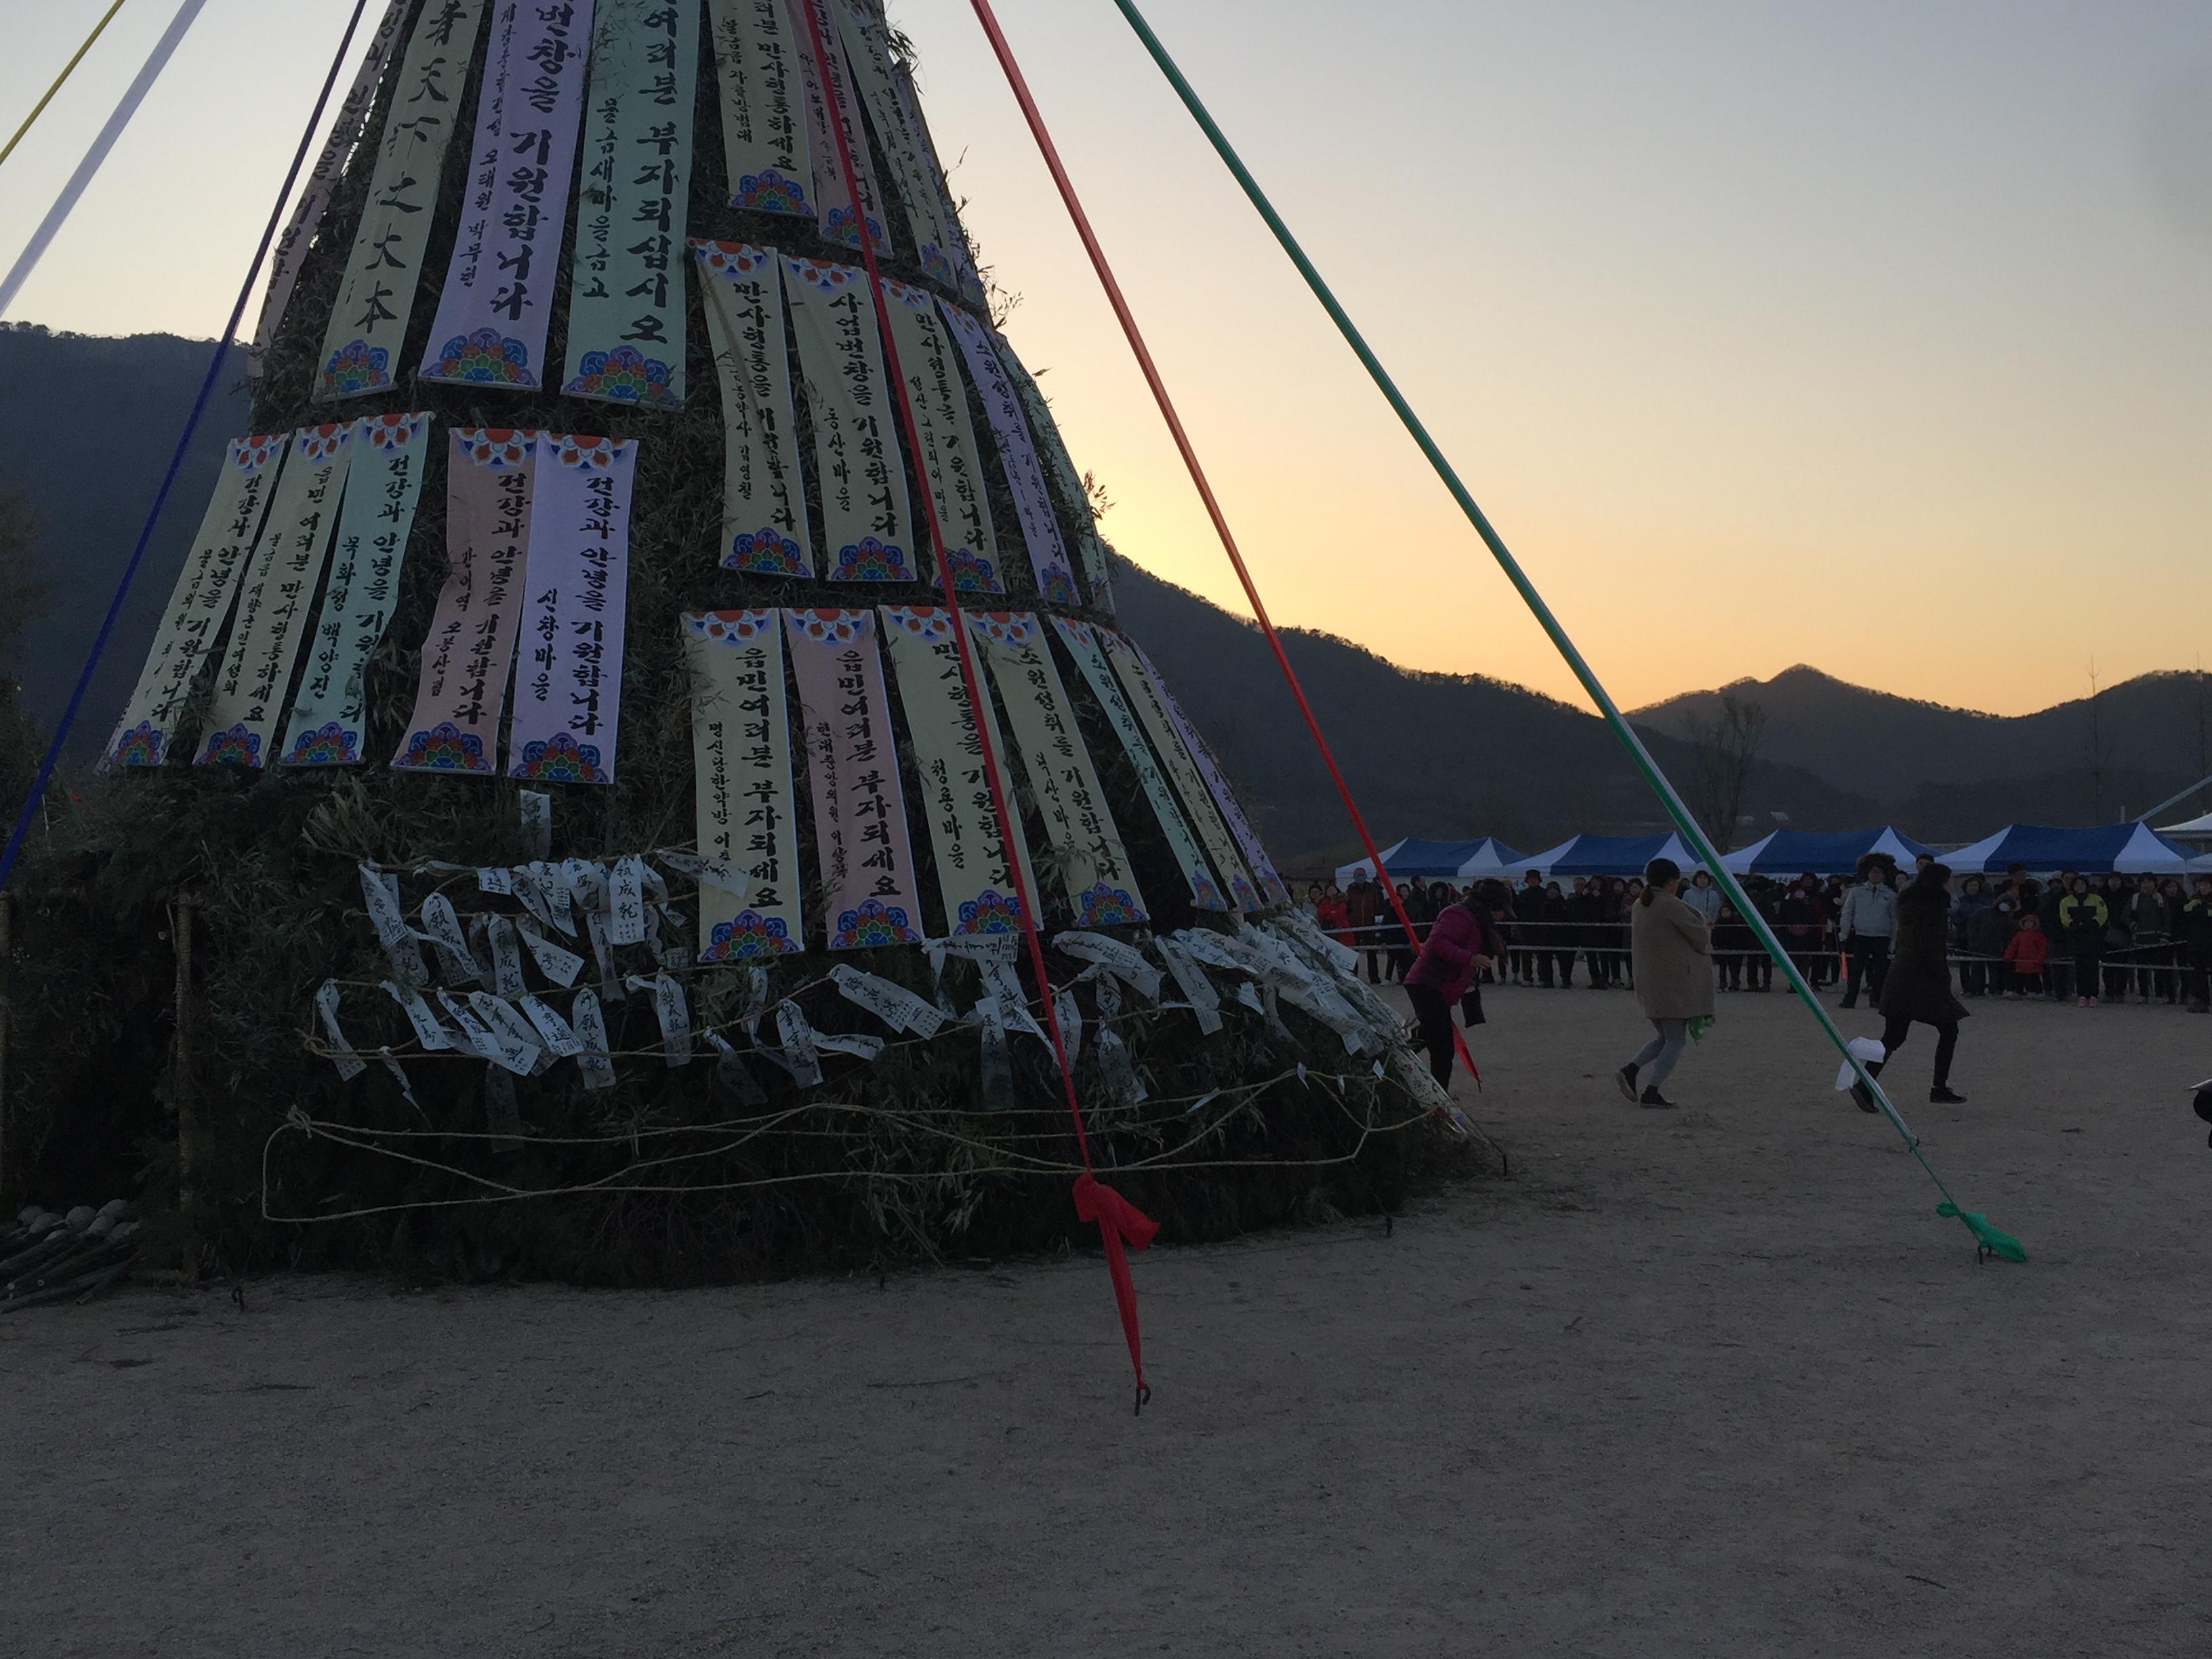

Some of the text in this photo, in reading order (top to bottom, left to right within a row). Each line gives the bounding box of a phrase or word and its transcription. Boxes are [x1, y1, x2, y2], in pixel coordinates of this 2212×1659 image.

[757, 42, 798, 171] 만사형통하세요
[490, 130, 550, 321] 기원합니다
[582, 97, 619, 298] 물금새마을금고
[733, 281, 796, 532] 만사형통을 기원합니다
[829, 292, 899, 537] 사업번창을 기원합니다
[227, 473, 263, 538] 건강과
[376, 454, 413, 523] 건강과
[942, 434, 987, 551] 기원합니다
[198, 545, 241, 609] 안녕을
[243, 466, 333, 722] 읍민 여러분 만사형통하세요
[363, 531, 401, 601] 안녕을
[452, 472, 532, 726] 건강과 안녕을 기원합니다
[567, 476, 621, 735] 건강과 안녕을 기원합니다
[151, 616, 211, 723] 기원합니다
[531, 588, 560, 702] 신창마을
[930, 758, 966, 870] 청룡마을
[932, 640, 1016, 889] 만사형통을 기원합니다
[1060, 766, 1122, 881] 기원합니다
[743, 779, 783, 909] 부자되세요
[851, 770, 902, 897] 부자되세요
